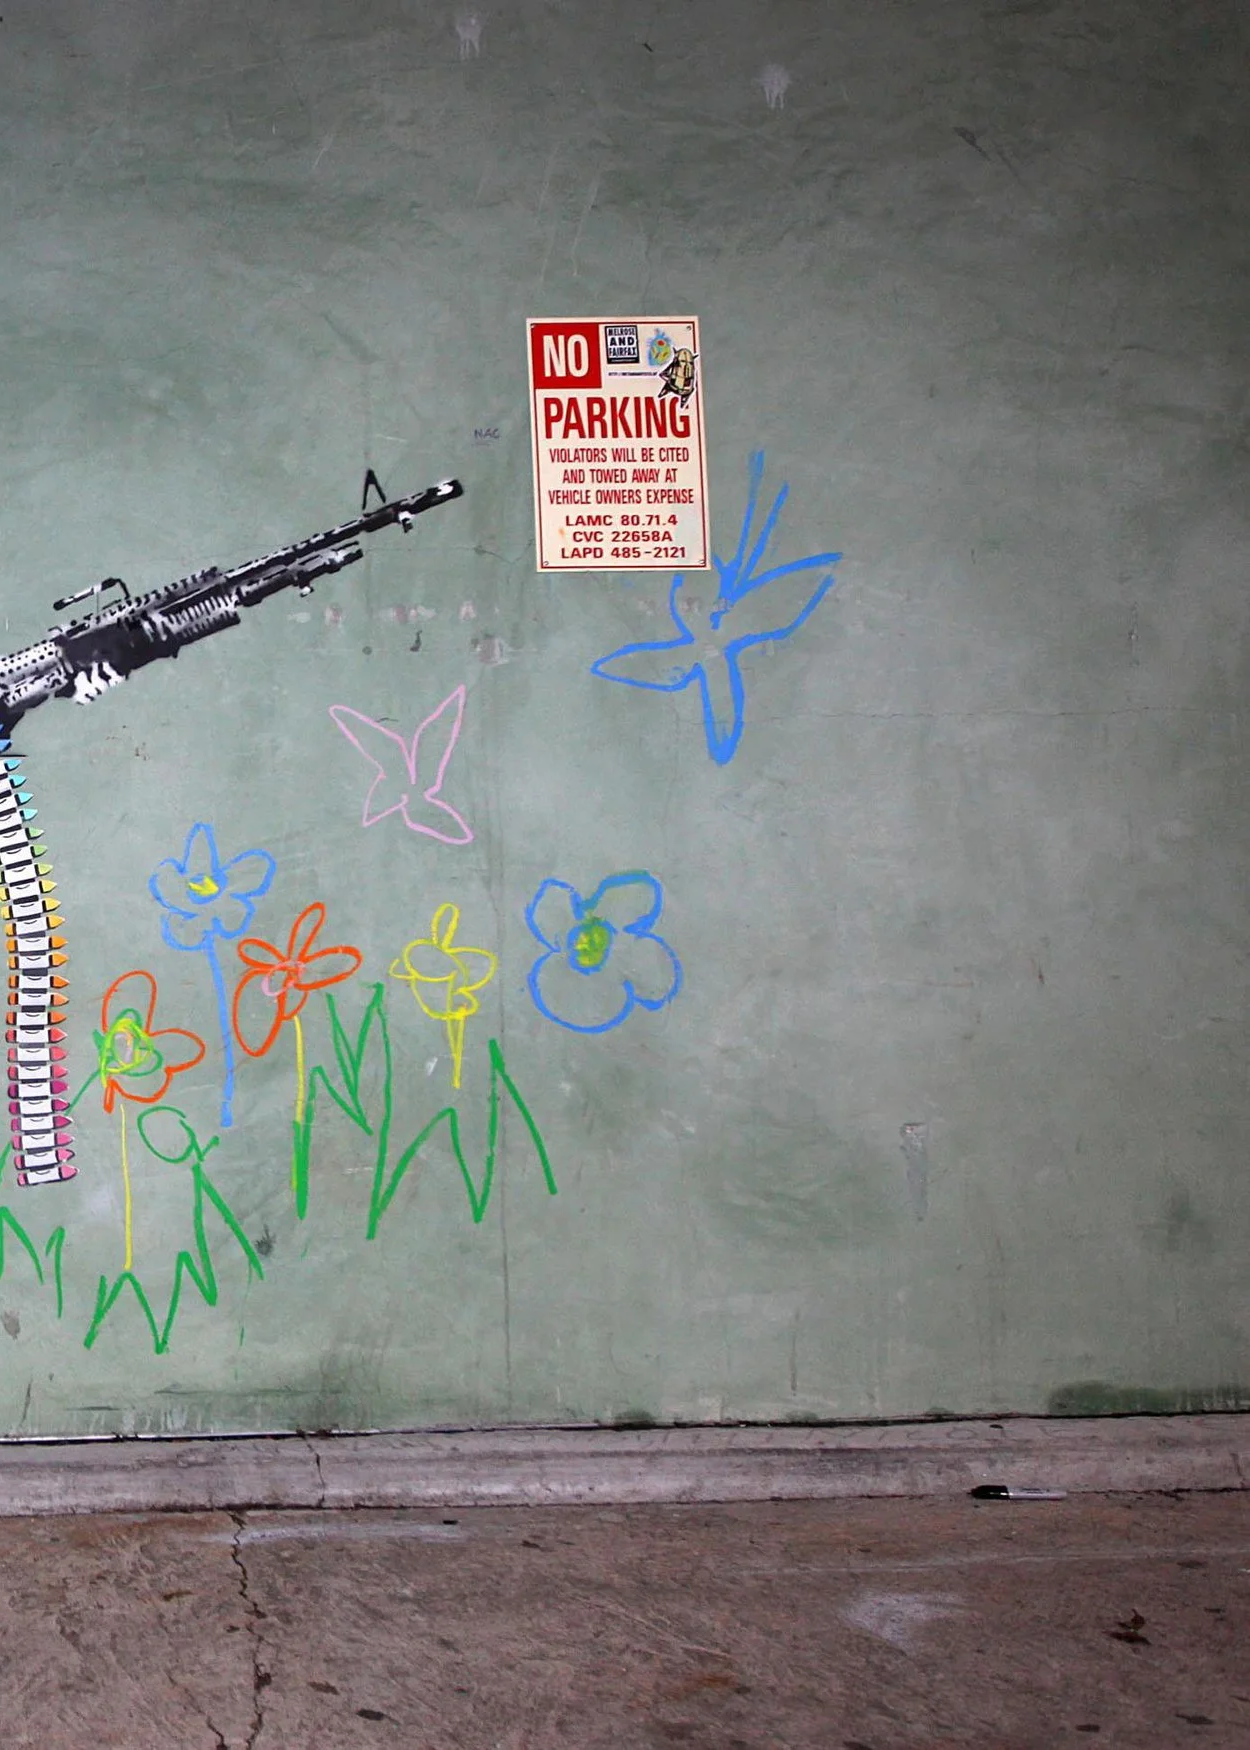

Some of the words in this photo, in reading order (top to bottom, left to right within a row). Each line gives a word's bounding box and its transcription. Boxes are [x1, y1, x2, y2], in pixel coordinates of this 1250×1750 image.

[608, 327, 635, 335] MELROSE
[610, 337, 634, 346] AND
[544, 335, 588, 377] NO
[609, 347, 636, 356] FAIRFAX
[544, 396, 690, 439] PARKING
[550, 448, 607, 463] VIOLATORS
[612, 448, 637, 462] WILL
[641, 448, 654, 462] BE
[659, 447, 689, 462] CITED
[563, 469, 585, 483] AND
[590, 469, 627, 483] TOWED
[632, 469, 660, 483] AWAY
[665, 468, 677, 482] AT
[549, 490, 591, 504] VEHICLE
[596, 489, 641, 504] OWNERS
[647, 489, 694, 504] EXPENSE
[566, 515, 612, 526] LAMC
[621, 515, 677, 526] 80.71.4
[573, 531, 603, 542] CVC
[612, 531, 672, 542] 22658A
[562, 547, 603, 558] LAPD
[611, 547, 685, 558] 485-2121
